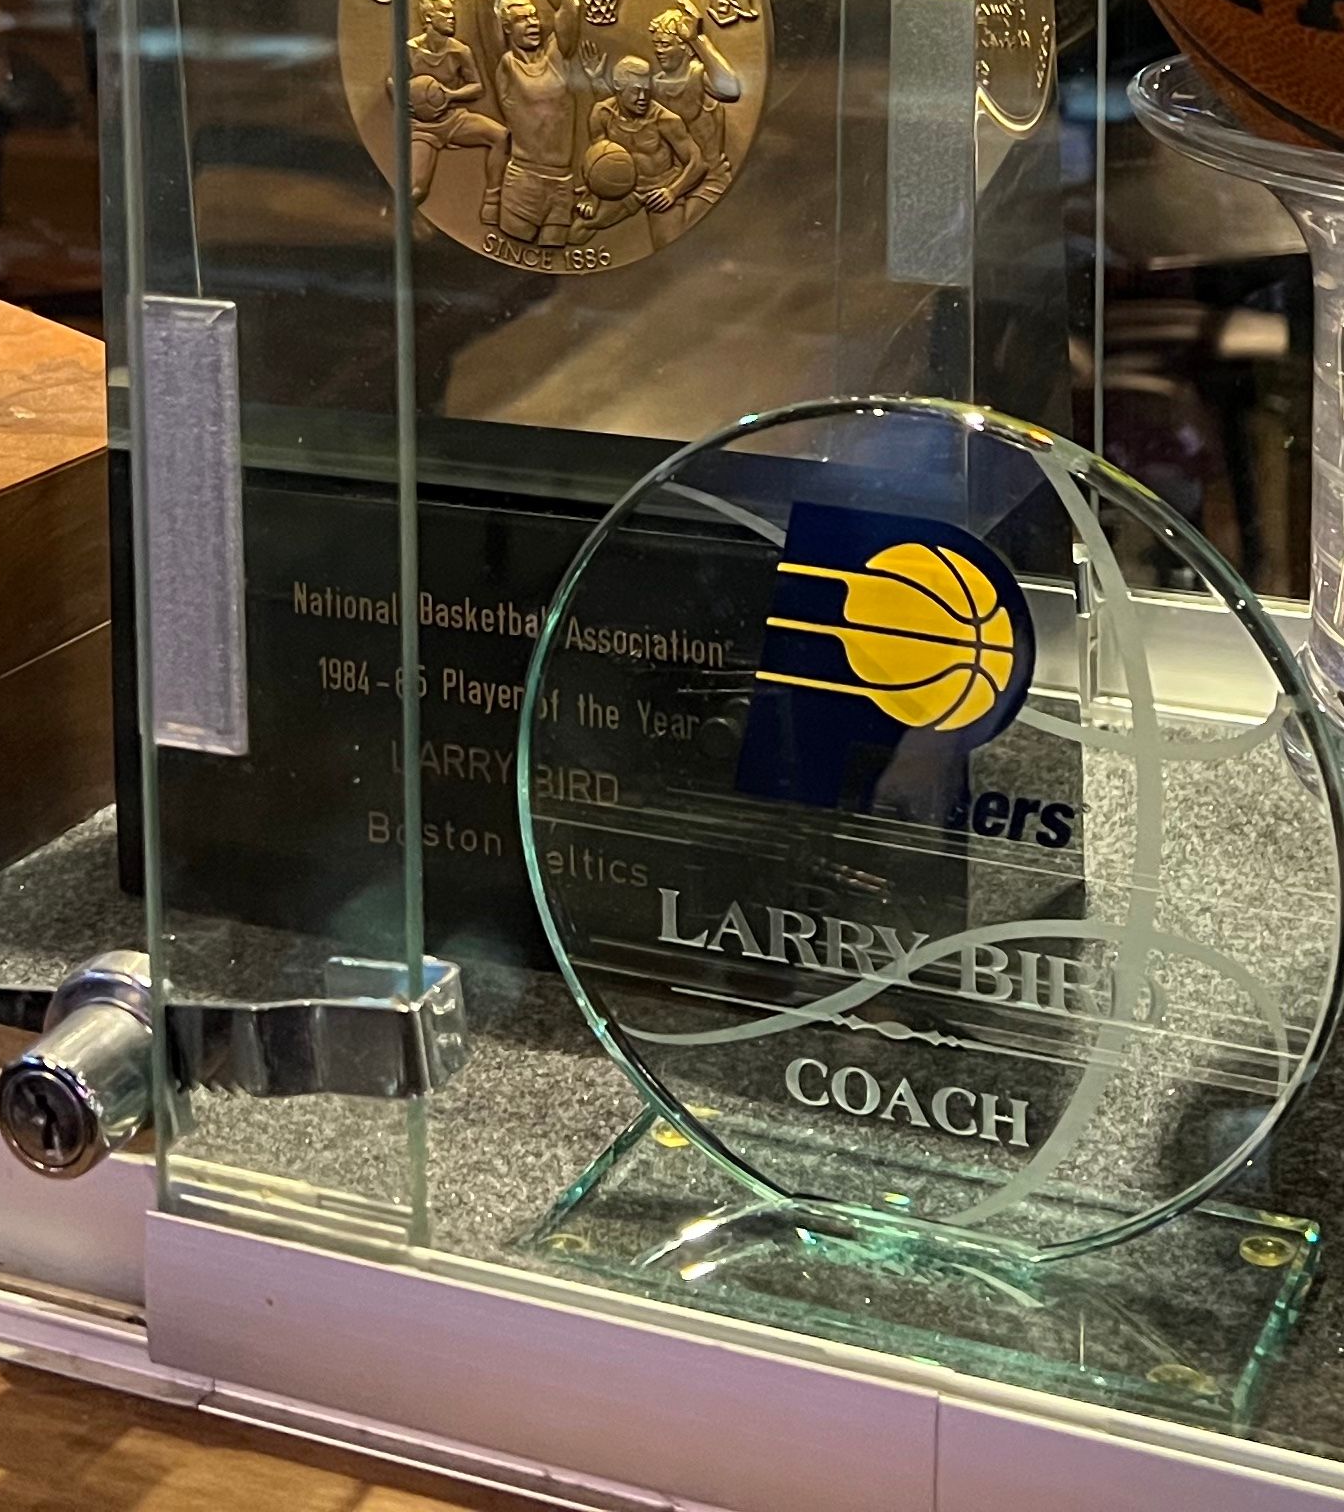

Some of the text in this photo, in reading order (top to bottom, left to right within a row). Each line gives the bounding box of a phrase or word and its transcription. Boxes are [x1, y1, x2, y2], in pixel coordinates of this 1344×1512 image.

[482, 233, 553, 271] SINCE
[293, 581, 400, 627] National
[565, 616, 726, 668] Association
[442, 668, 525, 713] Player
[577, 694, 621, 731] the
[638, 699, 701, 741] Year
[535, 765, 620, 807] BIRD
[545, 848, 648, 888] eltics
[657, 888, 930, 986] LARRY
[784, 1057, 1031, 1148] COACH
